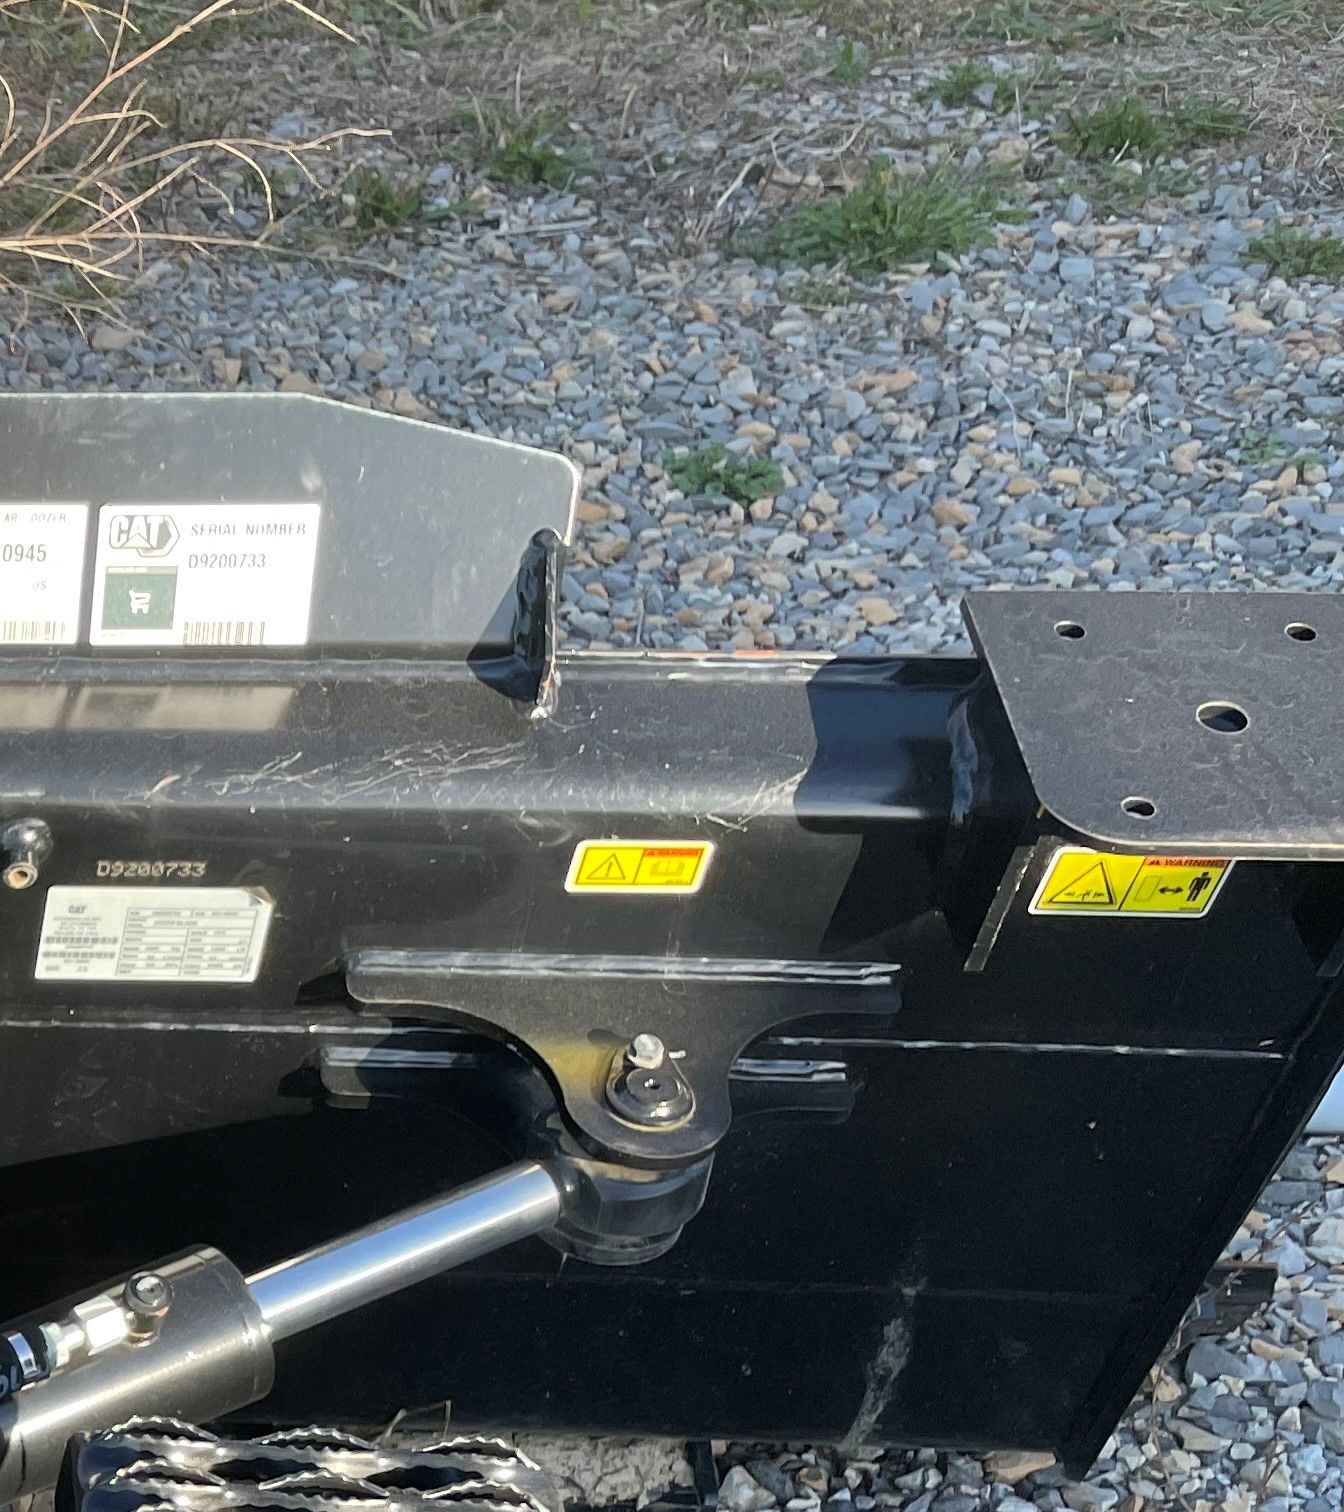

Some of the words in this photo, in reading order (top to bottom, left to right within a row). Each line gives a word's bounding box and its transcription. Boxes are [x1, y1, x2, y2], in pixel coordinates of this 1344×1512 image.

[109, 514, 164, 549] CAT
[190, 523, 238, 537] SERIAL
[245, 522, 307, 536] NUMBER
[188, 553, 267, 569] D9200733
[96, 860, 208, 878] D9200733
